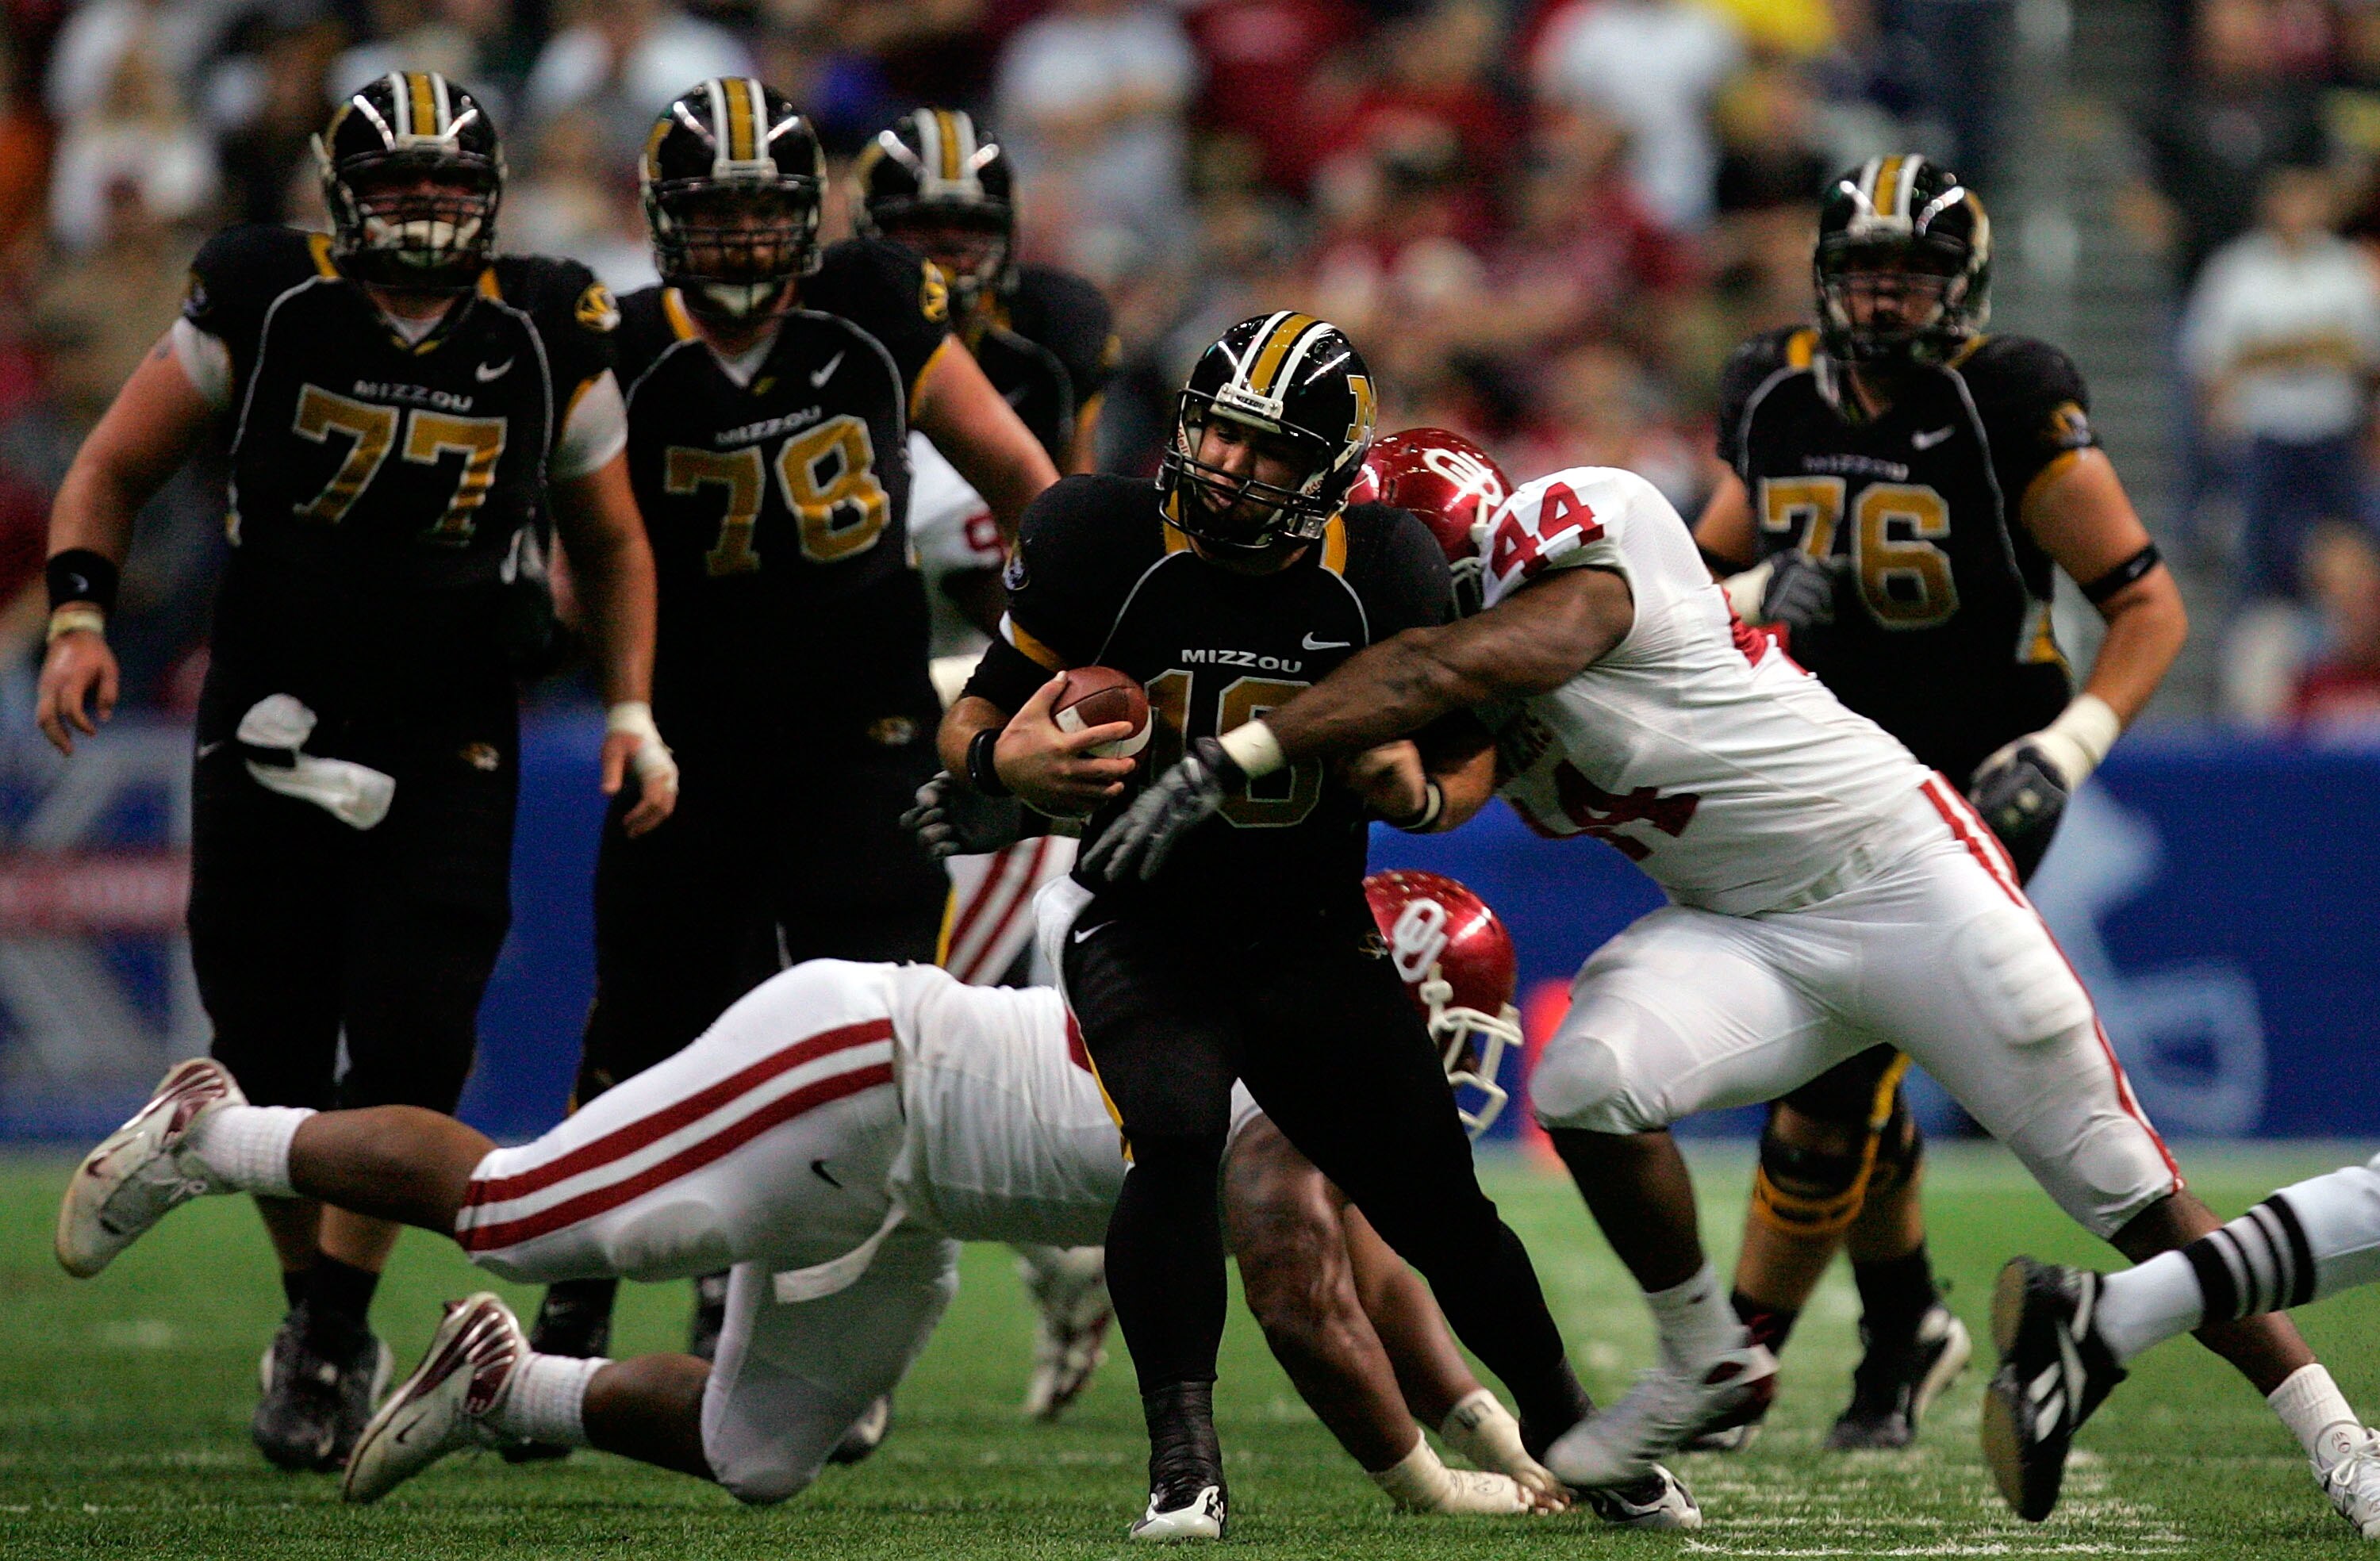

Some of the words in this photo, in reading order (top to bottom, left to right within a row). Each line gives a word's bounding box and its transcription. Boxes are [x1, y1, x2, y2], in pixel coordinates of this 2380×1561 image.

[291, 382, 509, 547] 77
[663, 413, 892, 577] 78
[1491, 481, 1604, 582] 44
[1757, 474, 1961, 632] 76
[1181, 649, 1302, 673] MIZZOU
